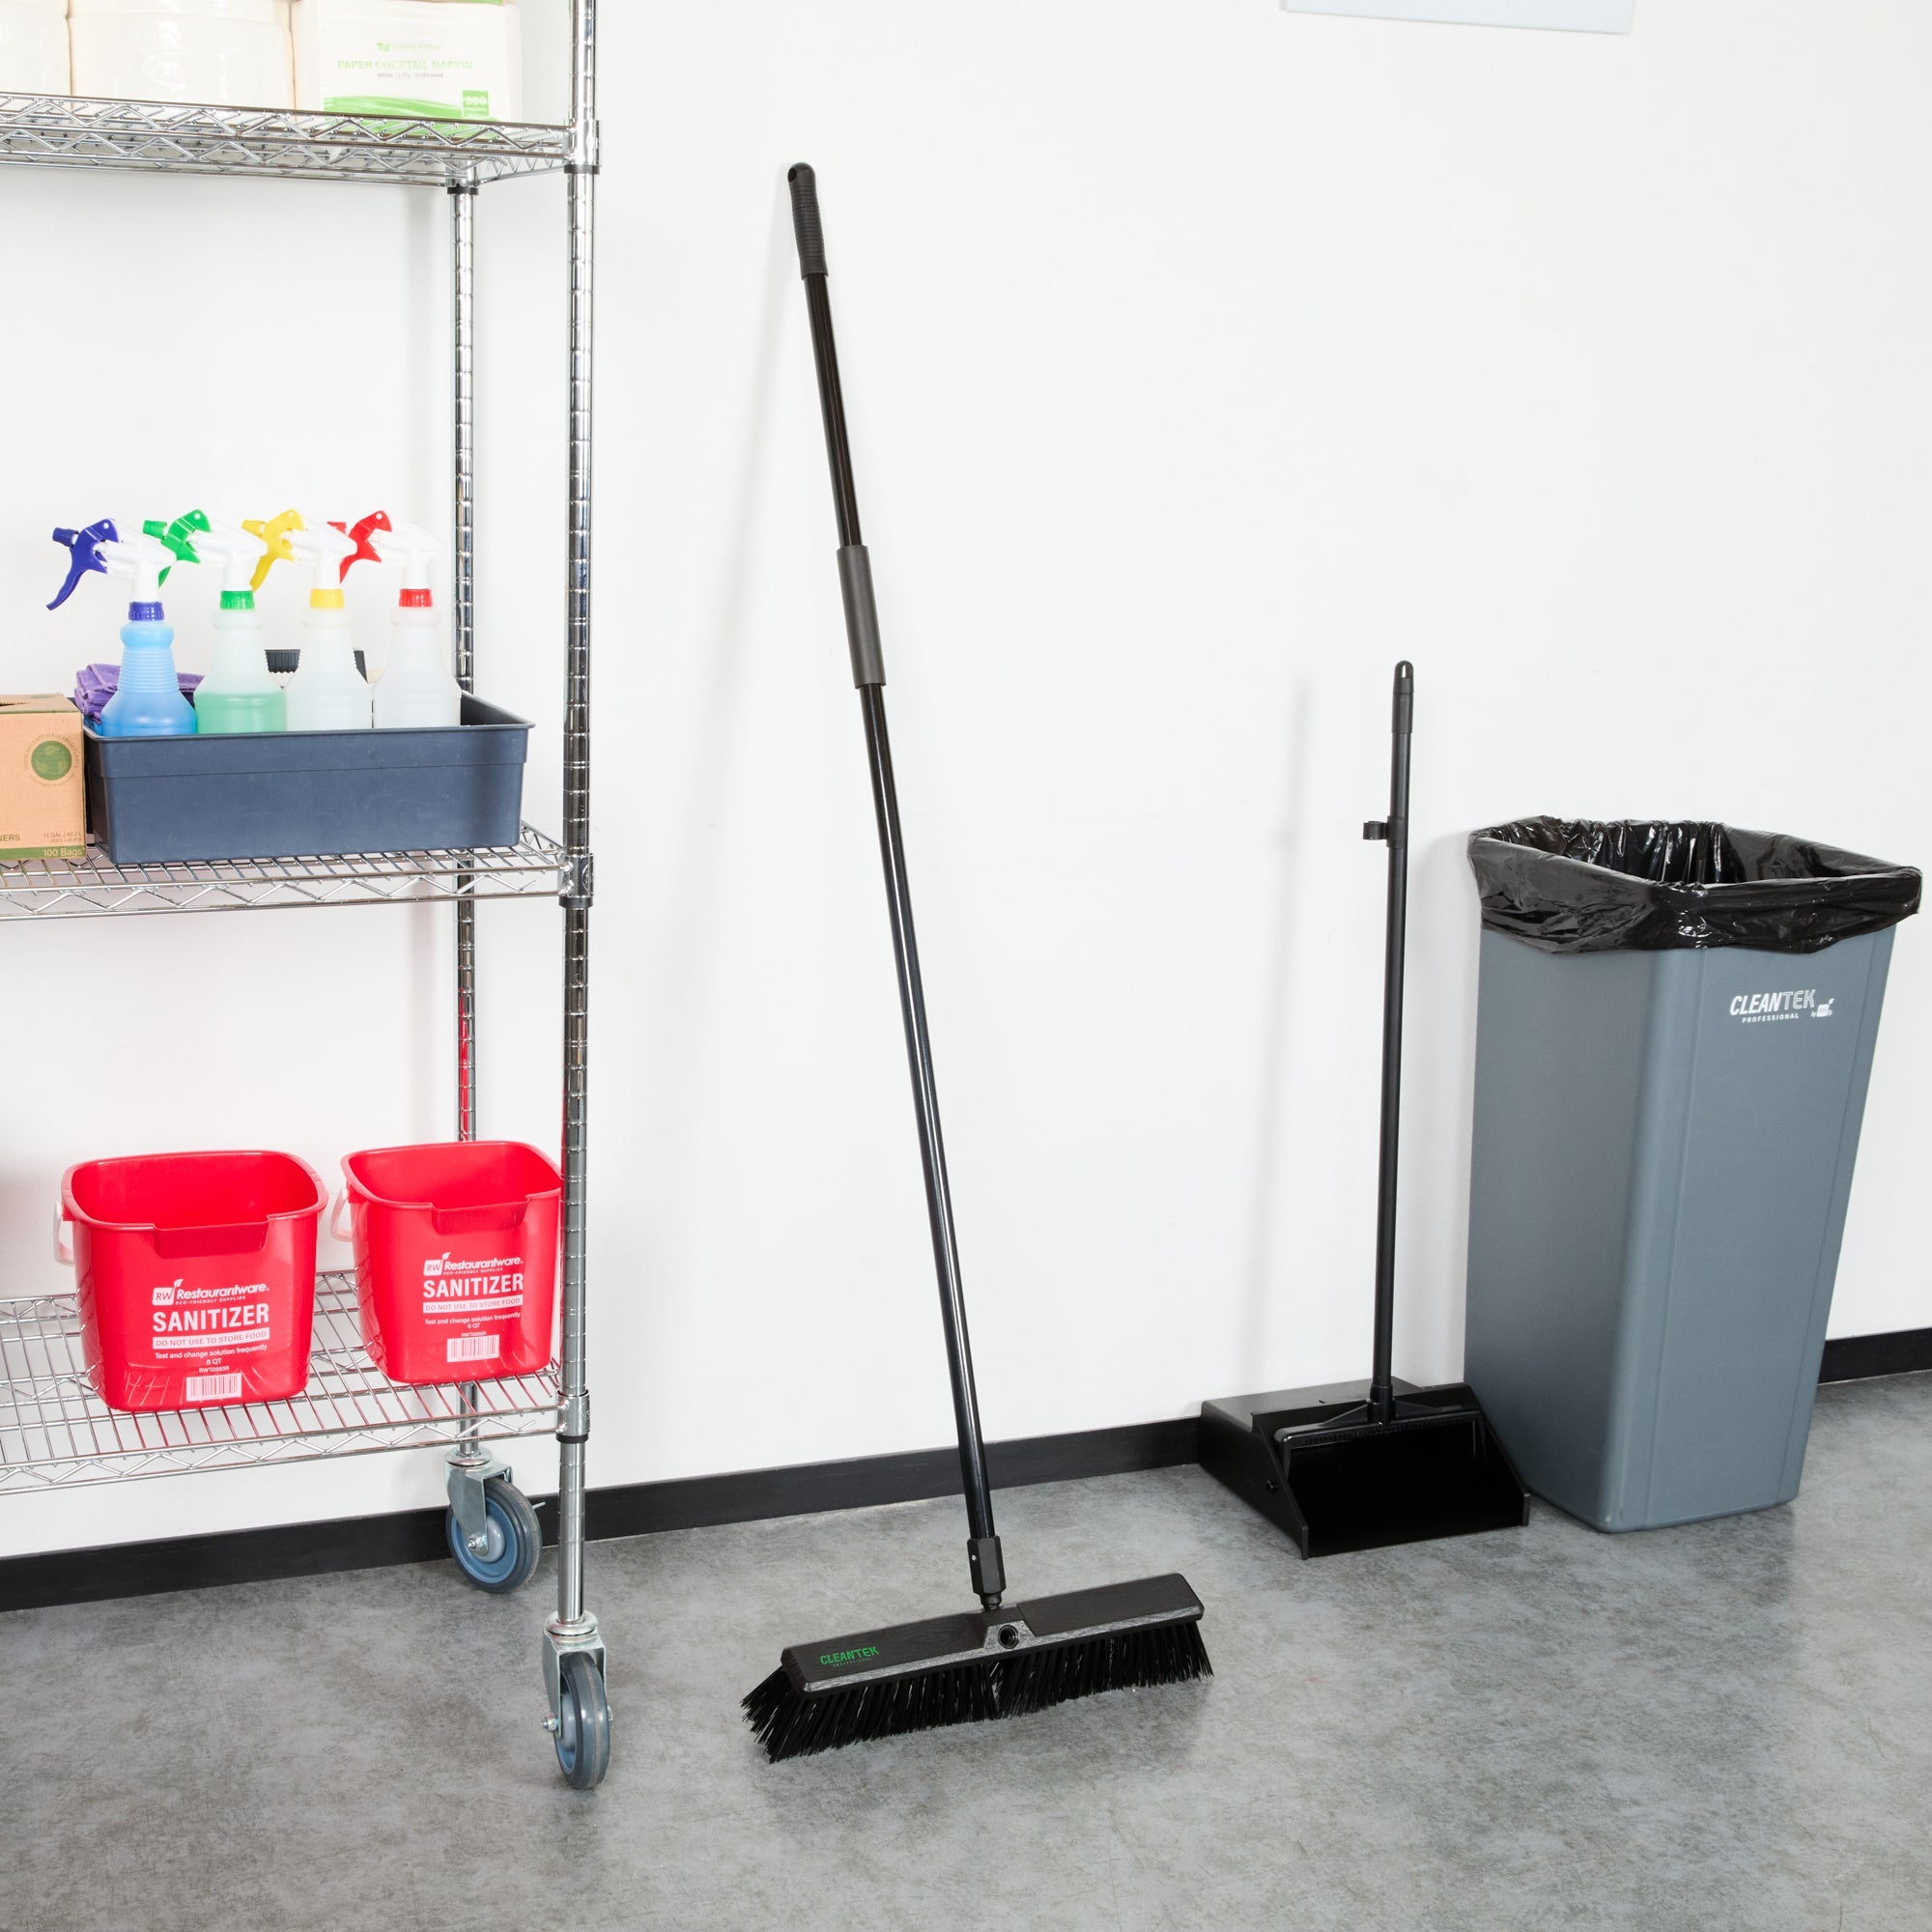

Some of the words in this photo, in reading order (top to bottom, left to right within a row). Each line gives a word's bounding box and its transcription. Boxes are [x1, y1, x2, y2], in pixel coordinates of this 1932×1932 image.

[337, 60, 372, 70] PAPER
[375, 60, 428, 70] COCKTAIL
[432, 60, 473, 70] NAPKIN
[61, 847, 83, 857] Bags
[1729, 989, 1816, 1015] CLEANTEK
[1742, 1012, 1800, 1023] PROFESSIONAL
[426, 1264, 441, 1272] RW
[444, 1257, 521, 1270] Restaurantware
[156, 1292, 172, 1301] RW
[176, 1283, 267, 1300] Restaurantware
[423, 1273, 524, 1298] SANITIZER
[153, 1303, 270, 1332] SANITIZER
[494, 1312, 521, 1321] frequently
[218, 1334, 243, 1344] STORE
[245, 1331, 267, 1340] FOOD
[184, 1350, 208, 1359] change
[236, 1344, 268, 1355] frequently
[820, 1646, 879, 1664] CLEANTEK
